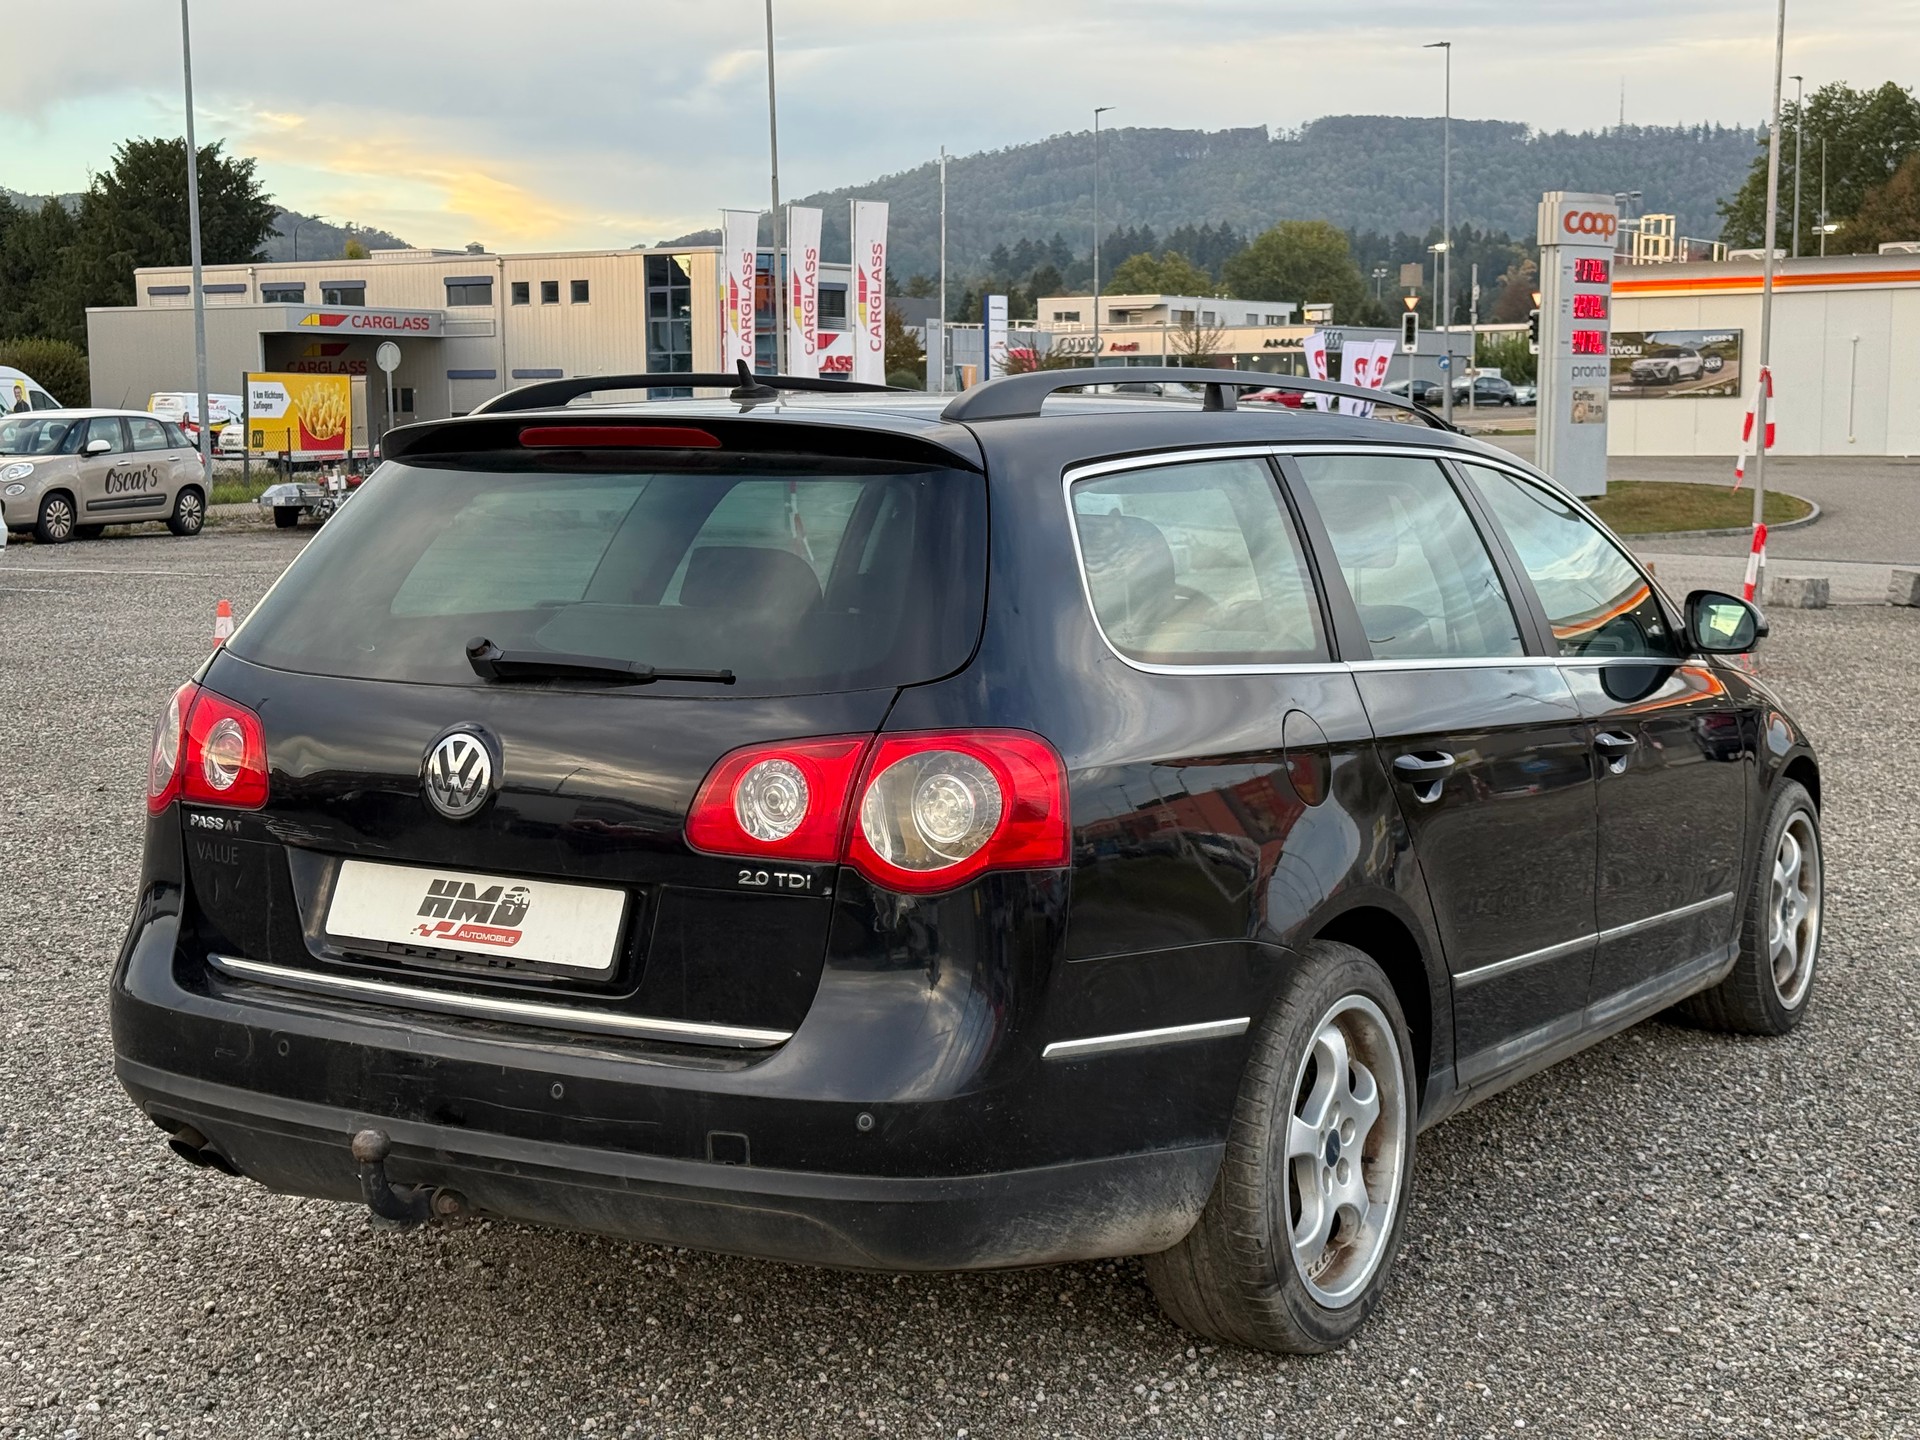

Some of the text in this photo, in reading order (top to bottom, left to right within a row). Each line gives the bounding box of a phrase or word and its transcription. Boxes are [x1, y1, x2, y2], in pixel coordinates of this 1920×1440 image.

[1563, 210, 1617, 242] coop
[741, 252, 753, 357] CARGLASS
[804, 248, 817, 355] CARGLASS
[869, 243, 884, 352] CARGLASS
[351, 315, 430, 331] CARGLASS
[1109, 342, 1140, 352] Audi
[1263, 337, 1304, 348] AMAG
[286, 360, 367, 374] CARGLASS
[1571, 364, 1607, 380] pronto
[105, 464, 158, 494] Oscar's
[190, 813, 242, 832] PASSAT
[196, 840, 239, 866] VALUE
[773, 872, 812, 890] TDI
[458, 929, 516, 944] AUTOMOBILE
